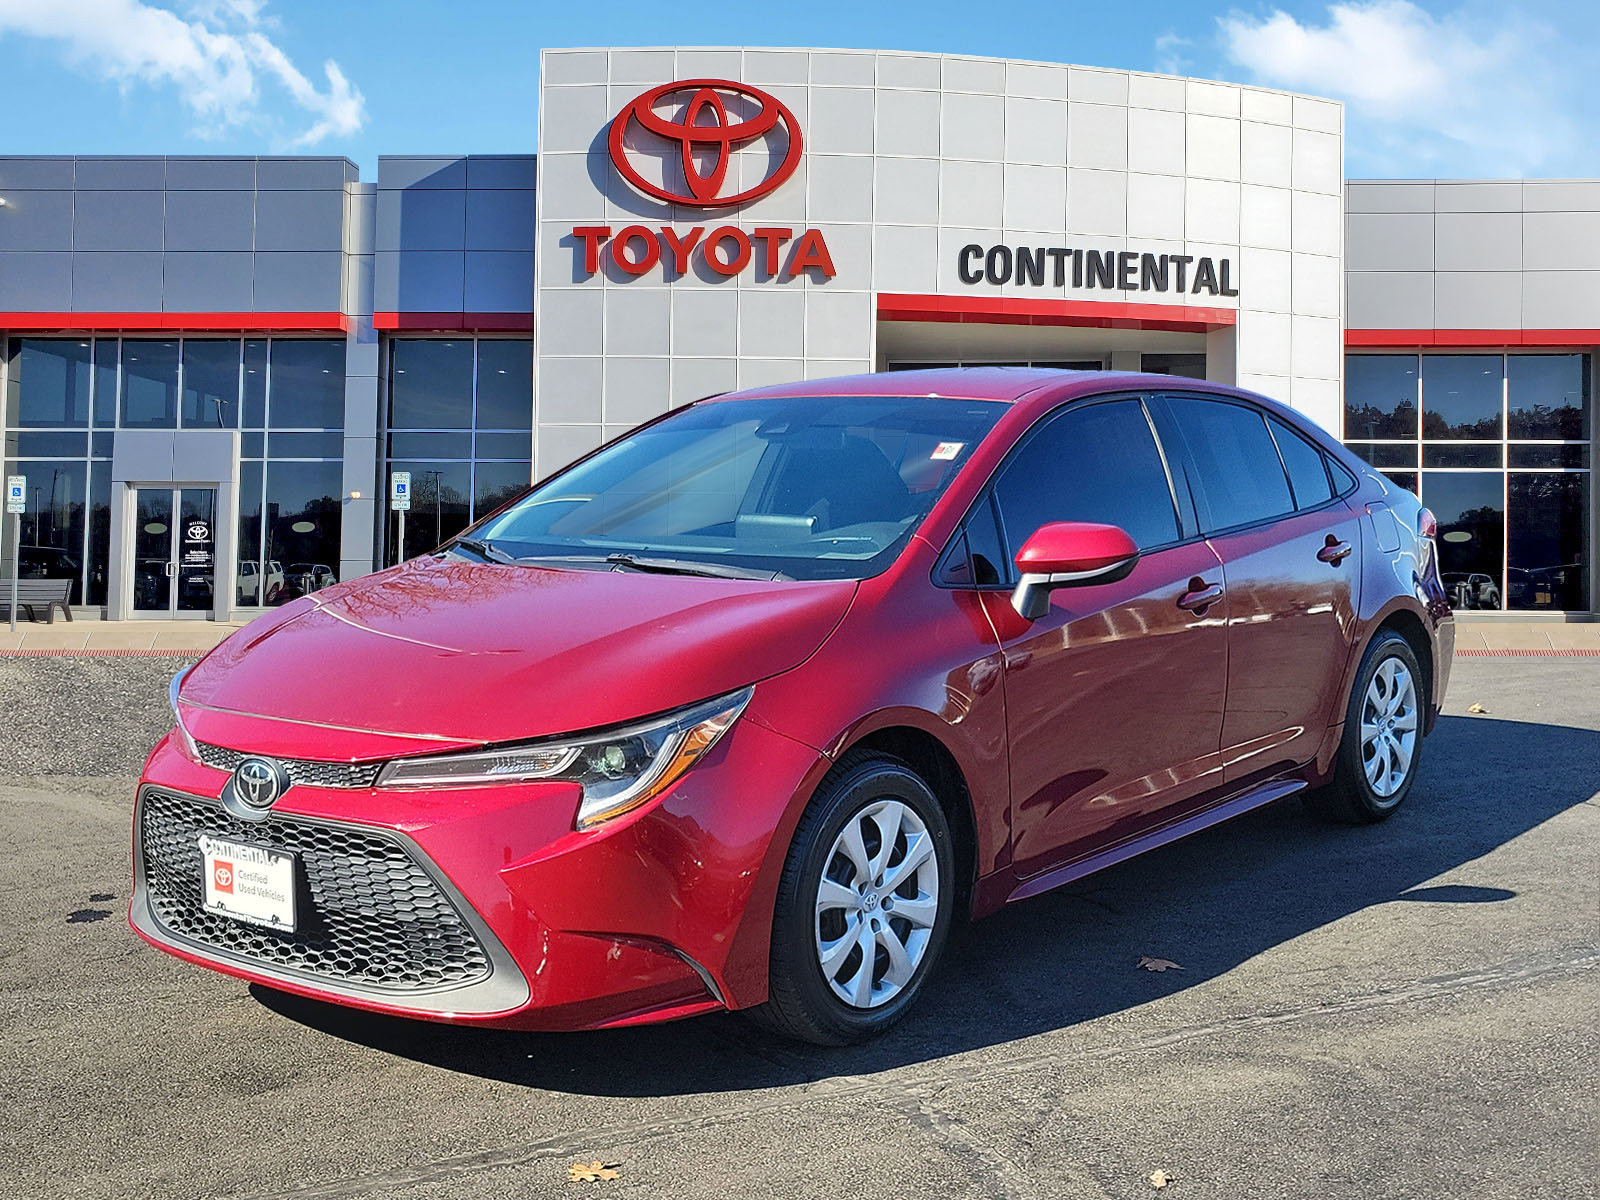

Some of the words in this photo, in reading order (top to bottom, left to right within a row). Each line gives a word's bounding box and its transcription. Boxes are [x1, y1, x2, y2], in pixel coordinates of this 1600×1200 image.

[573, 225, 836, 277] TOYOTA
[958, 244, 1239, 297] CONTINENTAL
[238, 870, 268, 885] Certified
[238, 883, 256, 895] Used
[257, 887, 285, 902] Vehicles
